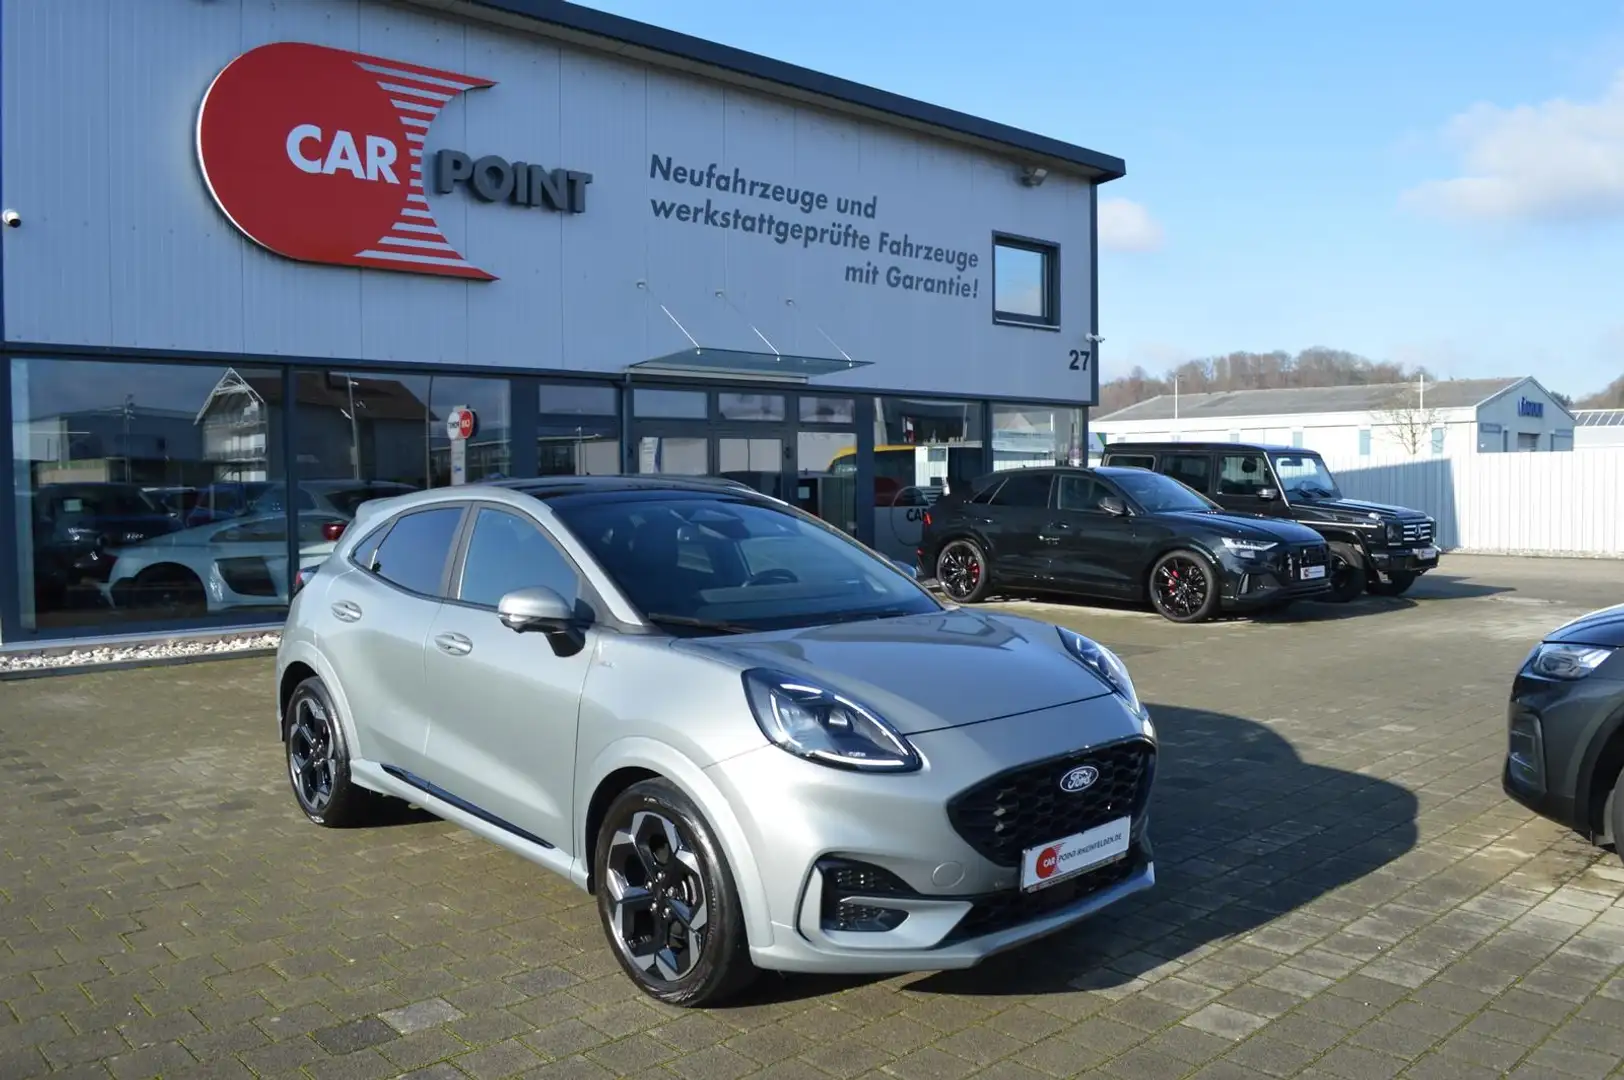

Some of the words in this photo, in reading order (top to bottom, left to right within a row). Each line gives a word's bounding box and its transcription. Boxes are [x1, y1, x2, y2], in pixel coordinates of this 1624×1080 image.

[286, 123, 400, 184] CAR
[436, 148, 592, 213] POINT
[650, 153, 828, 214] Neufahrzeuge
[836, 195, 877, 219] und
[650, 198, 870, 250] werkstattgeprüfte
[879, 231, 978, 272] Fahrzeuge
[844, 261, 879, 285] mit
[886, 265, 979, 299] Garantie!
[1069, 349, 1090, 371] 27
